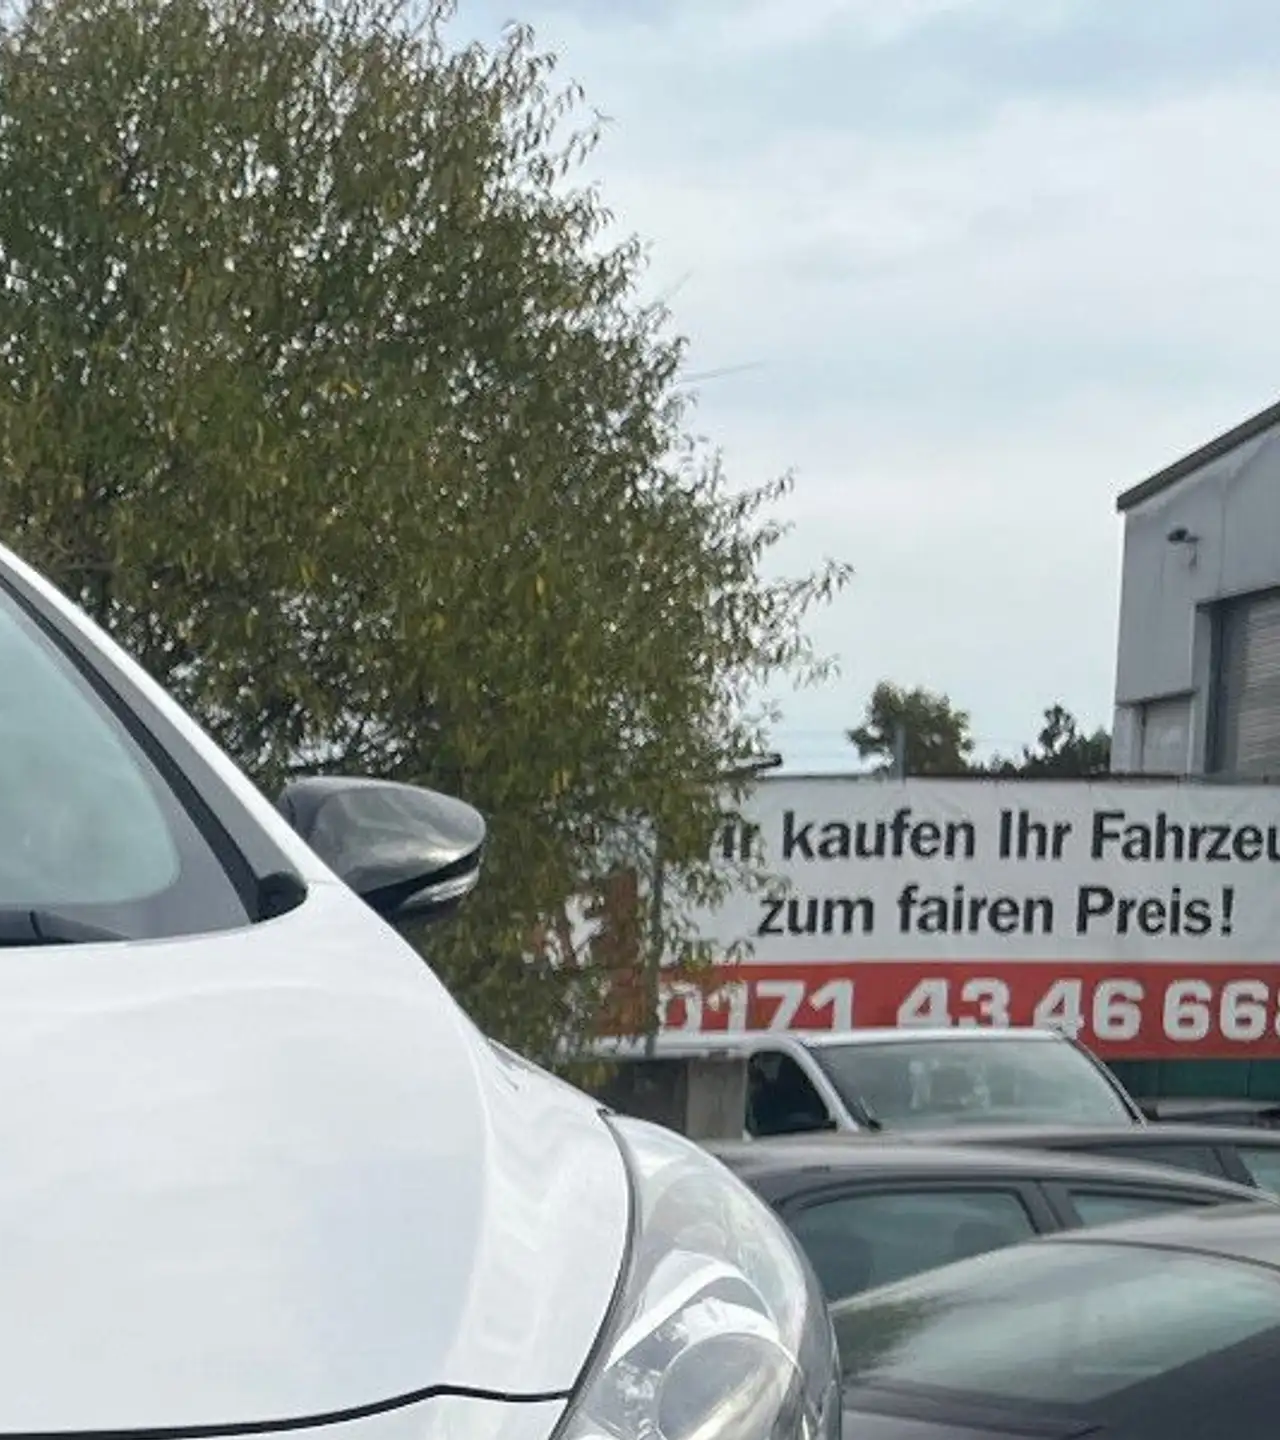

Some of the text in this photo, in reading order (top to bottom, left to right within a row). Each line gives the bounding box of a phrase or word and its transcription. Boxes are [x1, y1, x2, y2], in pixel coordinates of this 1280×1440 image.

[782, 808, 975, 860] kaufen
[999, 809, 1071, 860] Ihr
[756, 884, 1235, 936] zum fairen Preis!
[896, 977, 1011, 1029] 43
[1033, 978, 1145, 1042] 46
[1162, 978, 1279, 1042] 66
